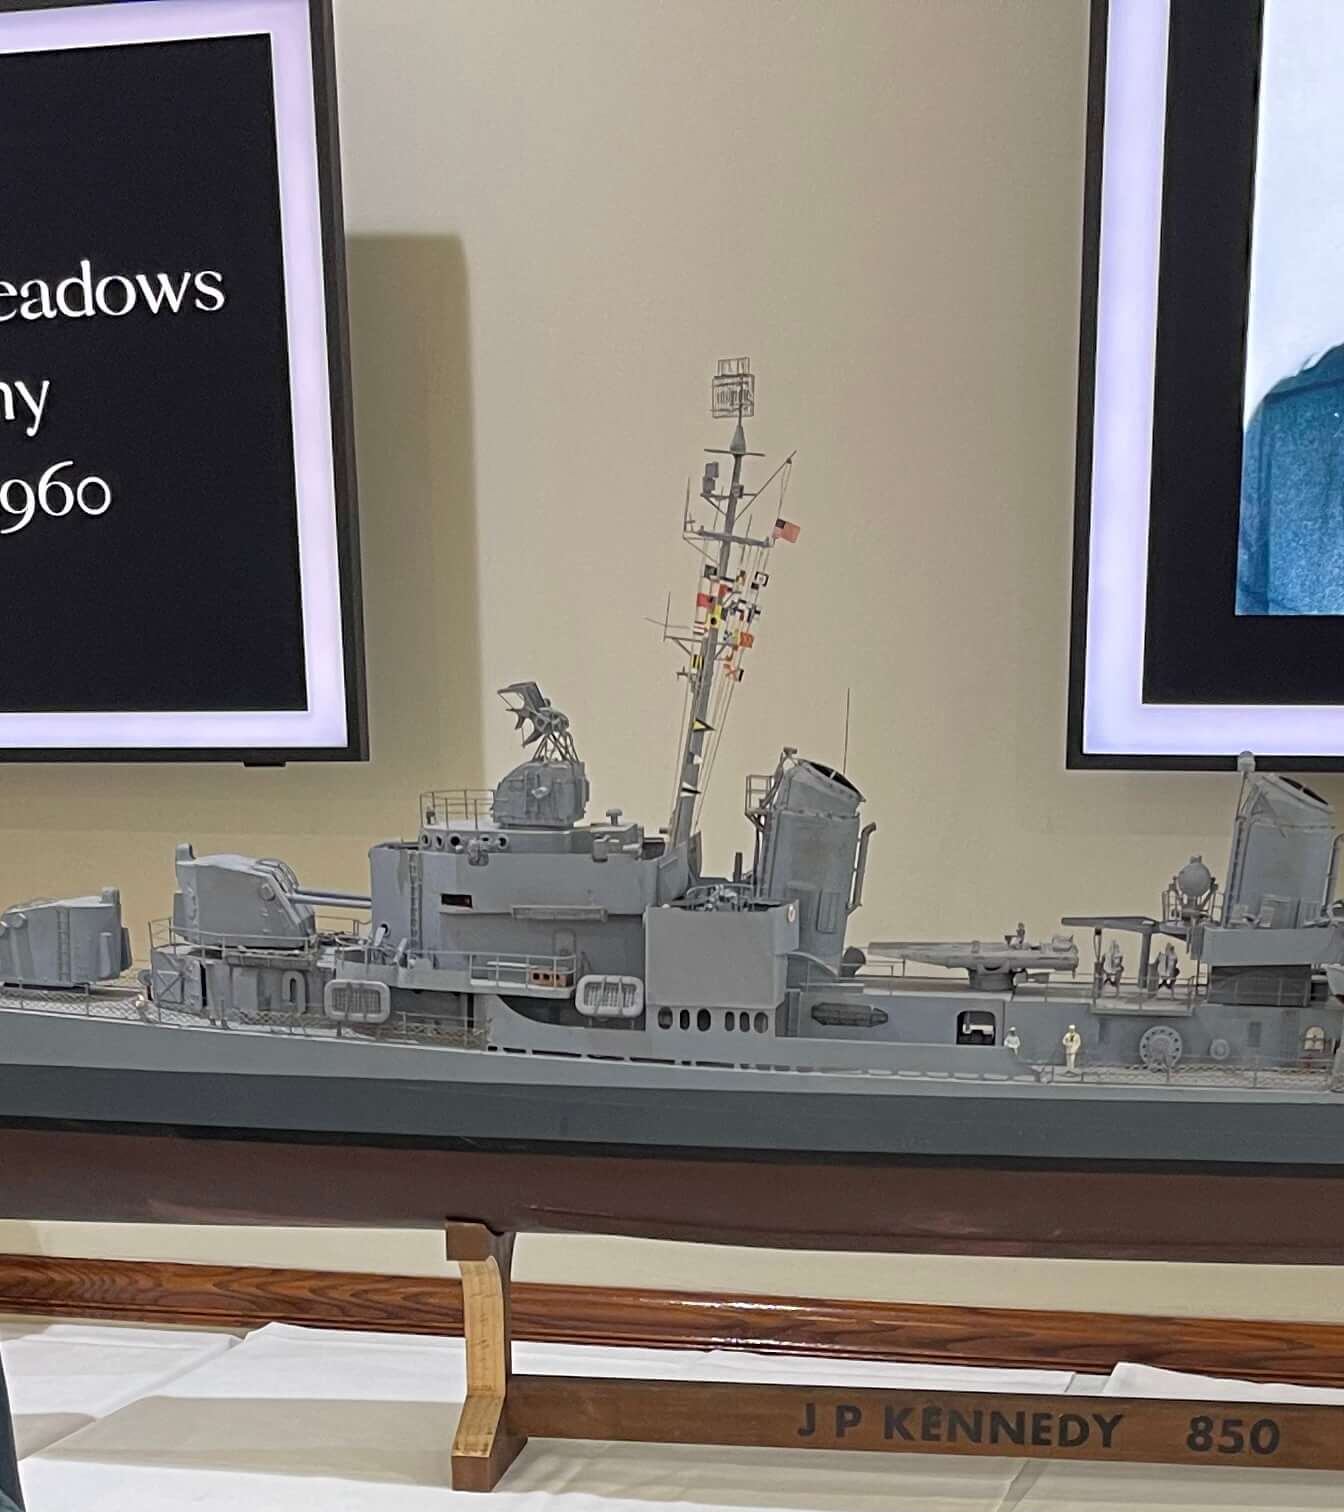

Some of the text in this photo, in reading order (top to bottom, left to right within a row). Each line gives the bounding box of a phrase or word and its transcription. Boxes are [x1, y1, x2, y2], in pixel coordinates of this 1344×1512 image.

[797, 1402, 1282, 1456] J P KENNEDY 850
